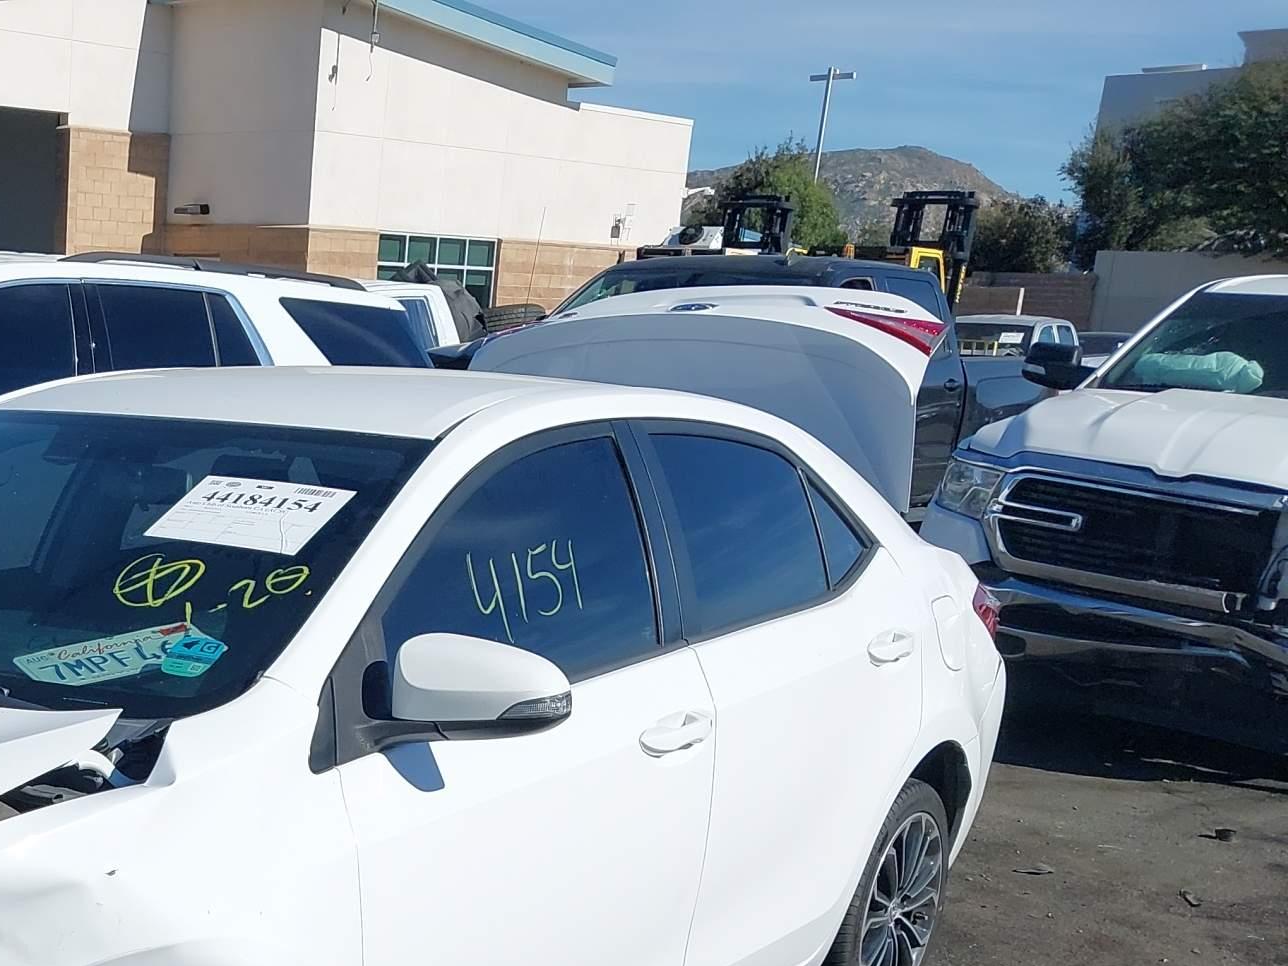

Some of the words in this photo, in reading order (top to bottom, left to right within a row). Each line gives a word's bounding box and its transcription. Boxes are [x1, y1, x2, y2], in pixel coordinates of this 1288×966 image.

[202, 490, 322, 513] 44184154
[466, 539, 583, 644] 4154
[56, 634, 158, 661] California
